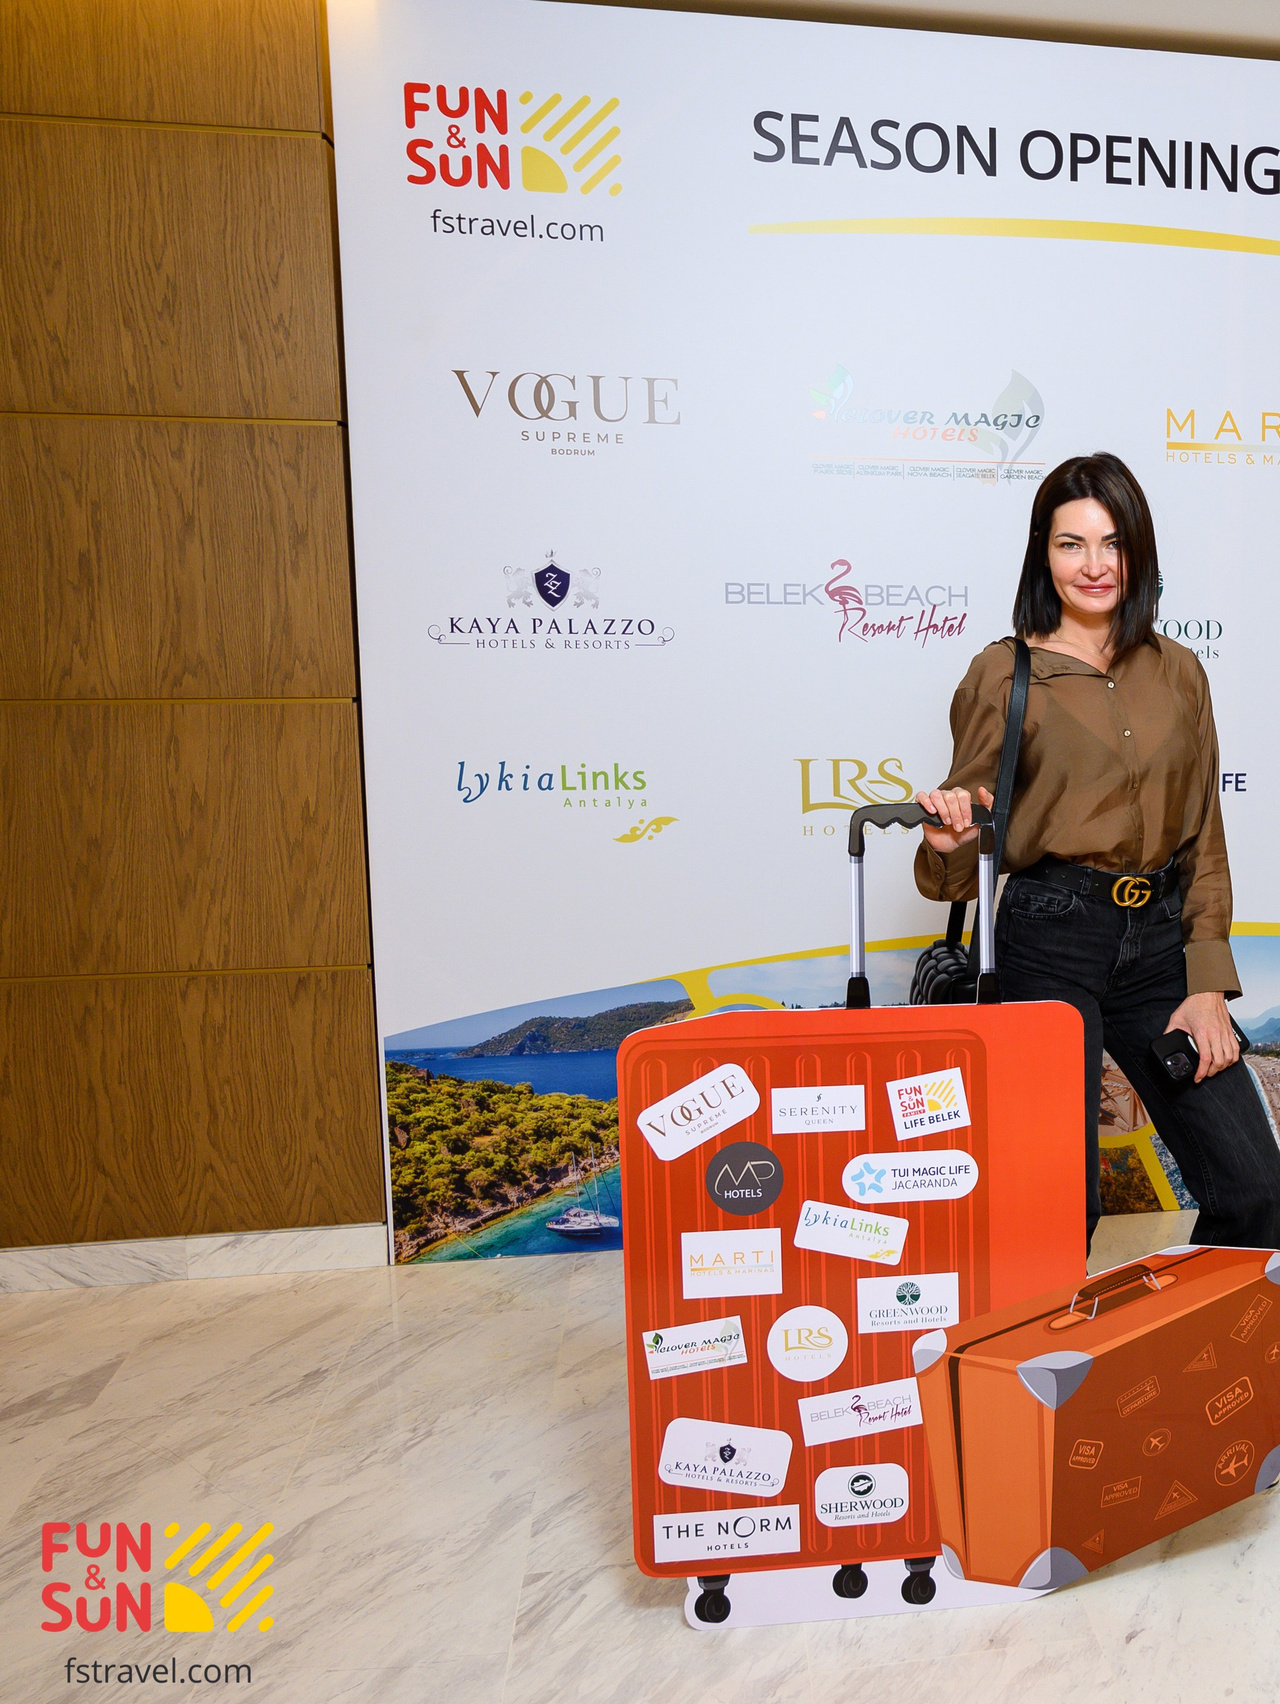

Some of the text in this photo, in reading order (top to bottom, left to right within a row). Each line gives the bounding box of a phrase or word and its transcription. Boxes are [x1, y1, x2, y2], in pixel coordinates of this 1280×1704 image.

[404, 82, 508, 135] FUN
[446, 124, 467, 149] &
[752, 110, 997, 178] SEASON
[1019, 128, 1280, 196] OPENING
[405, 138, 510, 190] SUN
[430, 208, 605, 242] fstravel.com
[450, 369, 682, 426] VOGUE
[944, 411, 1041, 431] MAGIC
[520, 430, 625, 445] SUPREME
[550, 448, 597, 457] BODRUM
[1165, 452, 1239, 466] HOTELS
[1245, 453, 1256, 466] &
[724, 582, 968, 608] BELEK BEACH
[448, 616, 656, 636] KAYA PALAZZO
[838, 602, 967, 648] Resort Hotel
[475, 638, 632, 650] HOTELS & RESORTS
[793, 757, 915, 815] LRS
[562, 796, 649, 810] Antalya
[802, 825, 911, 837] HOELS
[897, 1085, 922, 1100] FUN
[646, 1074, 745, 1138] VOGUE
[778, 1105, 858, 1117] SERENITY
[900, 1097, 925, 1112] SUN
[685, 1108, 728, 1136] SUPREME
[804, 1118, 835, 1126] QUEEN
[903, 1109, 961, 1130] LIFE BELEK
[891, 1164, 971, 1178] TUI MAGIC LIFE
[724, 1188, 763, 1199] HOTELS
[891, 1178, 958, 1191] JACARANDA
[848, 1232, 888, 1245] Antalya
[689, 1250, 774, 1268] MARTI
[869, 1305, 948, 1319] GREENWOOD
[903, 1317, 919, 1325] and
[921, 1315, 947, 1324] Hotels
[1240, 1309, 1256, 1327] VISA
[1240, 1300, 1268, 1339] APPROVED
[659, 1333, 741, 1354] CLOVER MAGIC
[781, 1327, 834, 1352] LRS
[785, 1353, 832, 1361] HOTELS
[1122, 1390, 1158, 1415] DEPARTURE
[1214, 1386, 1243, 1409] VISA
[1214, 1391, 1249, 1420] APPROVED
[810, 1394, 912, 1423] BELEK BEACH
[1072, 1455, 1096, 1464] APPROVED
[1078, 1445, 1096, 1456] VISA
[674, 1461, 772, 1482] KAYA PALAZZO
[685, 1472, 714, 1482] HOTELS
[725, 1477, 758, 1487] RESORTS
[1104, 1487, 1138, 1502] APPROVED
[1112, 1482, 1128, 1492] VISA
[820, 1497, 905, 1515] SHERWOOD
[662, 1516, 793, 1540] THE NORM
[706, 1542, 750, 1552] HOTELS
